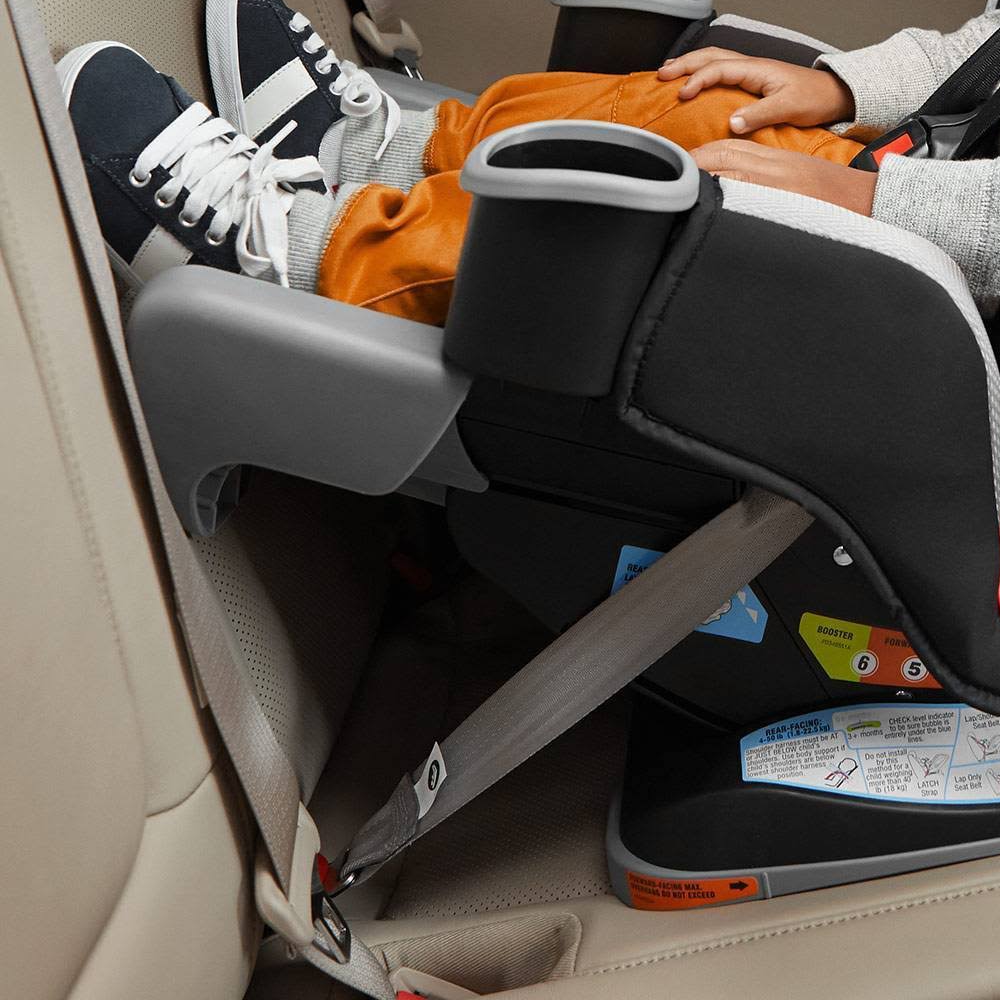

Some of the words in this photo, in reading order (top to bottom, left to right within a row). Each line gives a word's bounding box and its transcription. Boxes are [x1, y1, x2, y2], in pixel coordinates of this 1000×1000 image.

[817, 626, 854, 641] BOOSTER
[858, 656, 869, 670] 6
[908, 662, 921, 676] 5
[889, 717, 911, 725] CHECK
[928, 712, 954, 720] indicator
[766, 719, 822, 736] REAR-FACING:
[922, 720, 942, 728] bubble
[973, 721, 986, 729] Seat
[860, 729, 883, 737] months
[885, 731, 906, 740] entirely
[908, 729, 925, 737] under
[760, 735, 775, 743] 4-50
[775, 740, 801, 750] harness
[803, 736, 818, 744] must
[755, 751, 772, 759] JUST
[774, 746, 797, 755] BELOW
[796, 749, 812, 757] body
[815, 746, 839, 755] support
[888, 749, 907, 757] install
[770, 759, 802, 769] shoulders
[771, 765, 798, 775] shoulder
[801, 762, 826, 770] harness
[868, 764, 892, 773] method
[867, 773, 881, 781] child
[884, 770, 912, 779] weighing
[954, 775, 966, 783] Lap
[897, 784, 907, 792] kg)
[917, 780, 939, 789] LATCH
[970, 782, 982, 790] Belt
[922, 790, 938, 798] Strap
